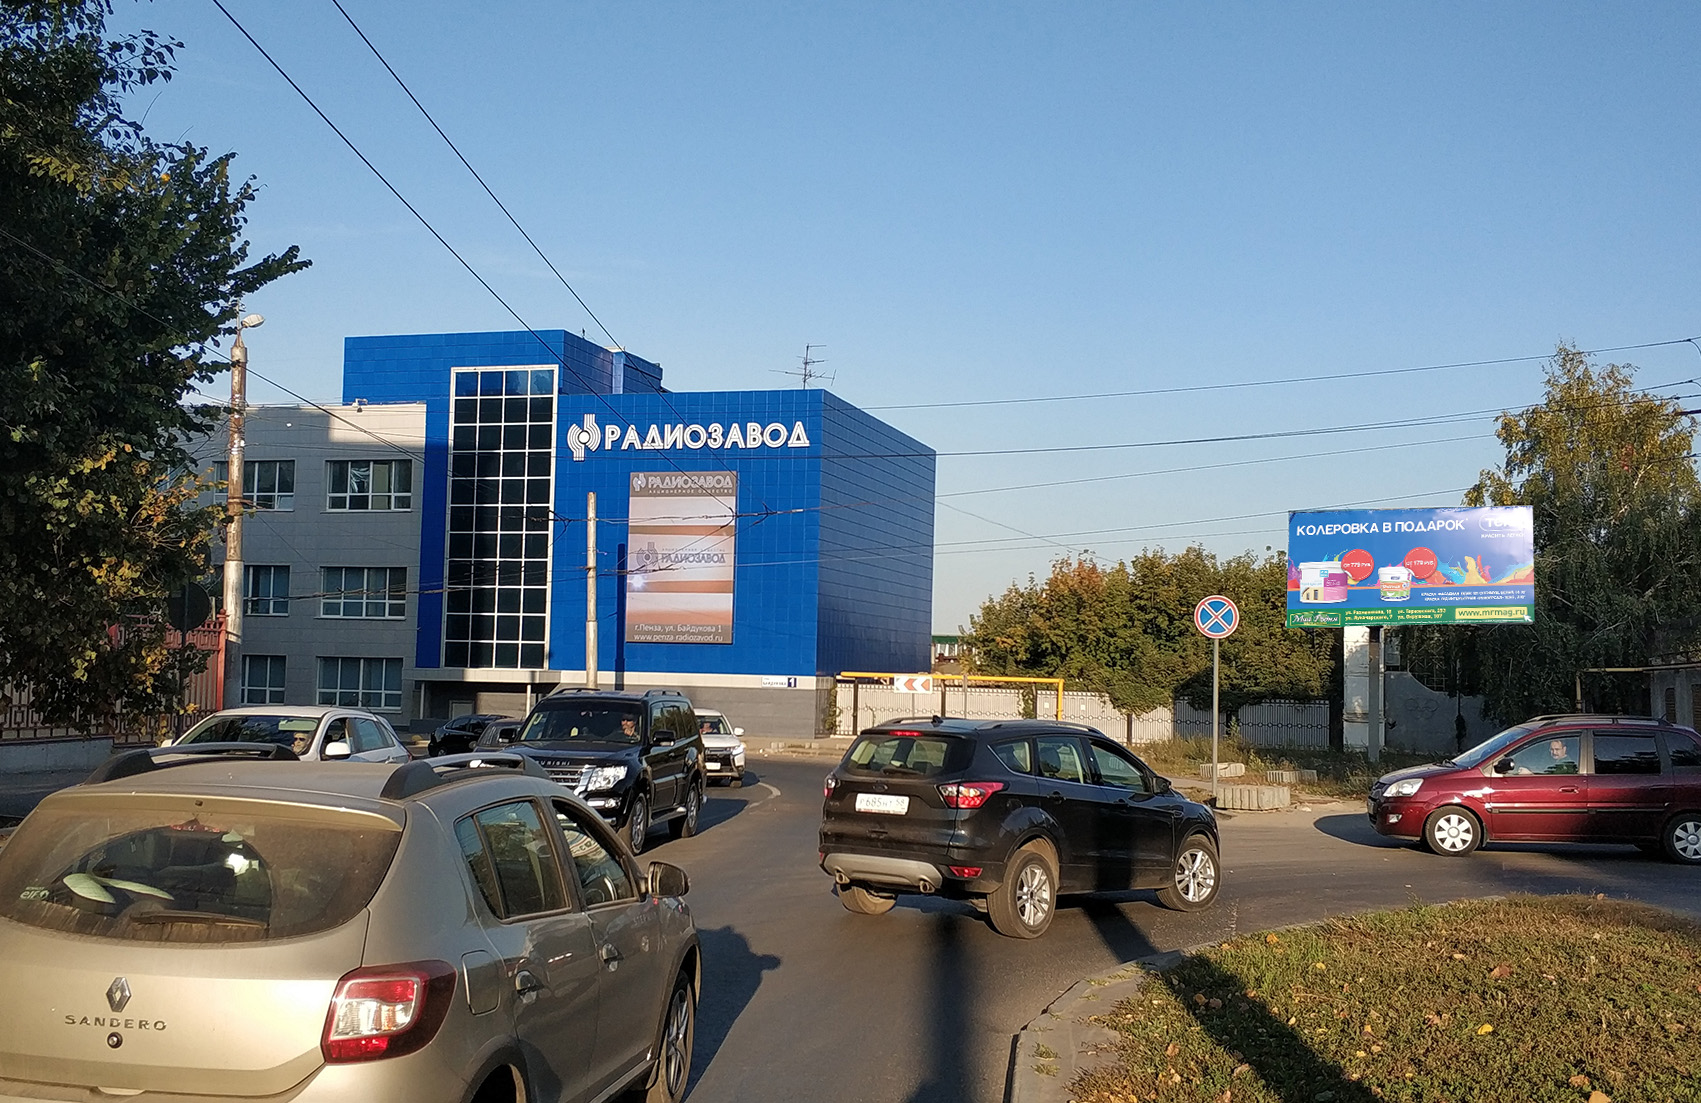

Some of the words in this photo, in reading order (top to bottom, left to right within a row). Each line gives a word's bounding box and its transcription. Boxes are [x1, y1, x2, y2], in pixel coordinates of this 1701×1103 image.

[604, 421, 810, 450] РАДИОЗАВОД
[648, 475, 732, 489] РАДИОЗАВОД
[1296, 522, 1379, 536] КОЛЕРОВКА
[1383, 522, 1392, 533] В
[1458, 608, 1525, 618] www.mrmag.ru
[64, 1014, 168, 1032] SANDERO
